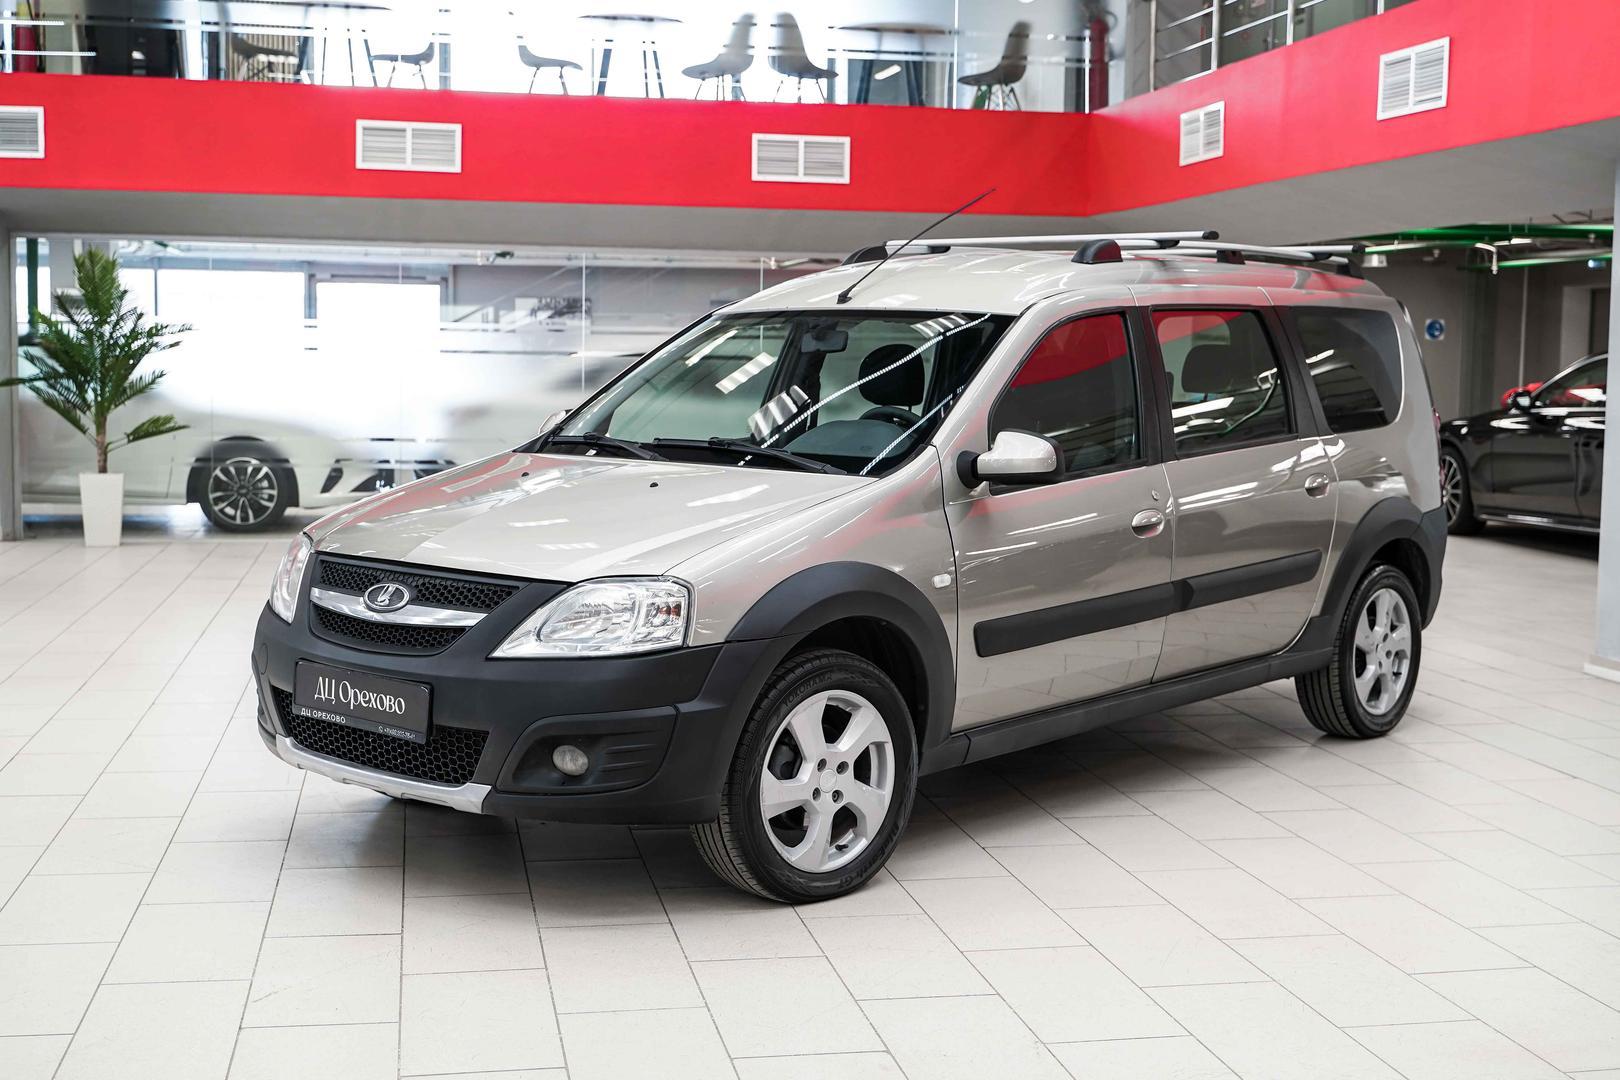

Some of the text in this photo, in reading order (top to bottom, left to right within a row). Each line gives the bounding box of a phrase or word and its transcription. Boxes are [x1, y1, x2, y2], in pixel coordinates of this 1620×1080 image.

[314, 676, 406, 715] ДЦ Орехово
[782, 671, 833, 706] YOKOHAMA
[300, 706, 347, 724] ДЦ ОРЕХОВО
